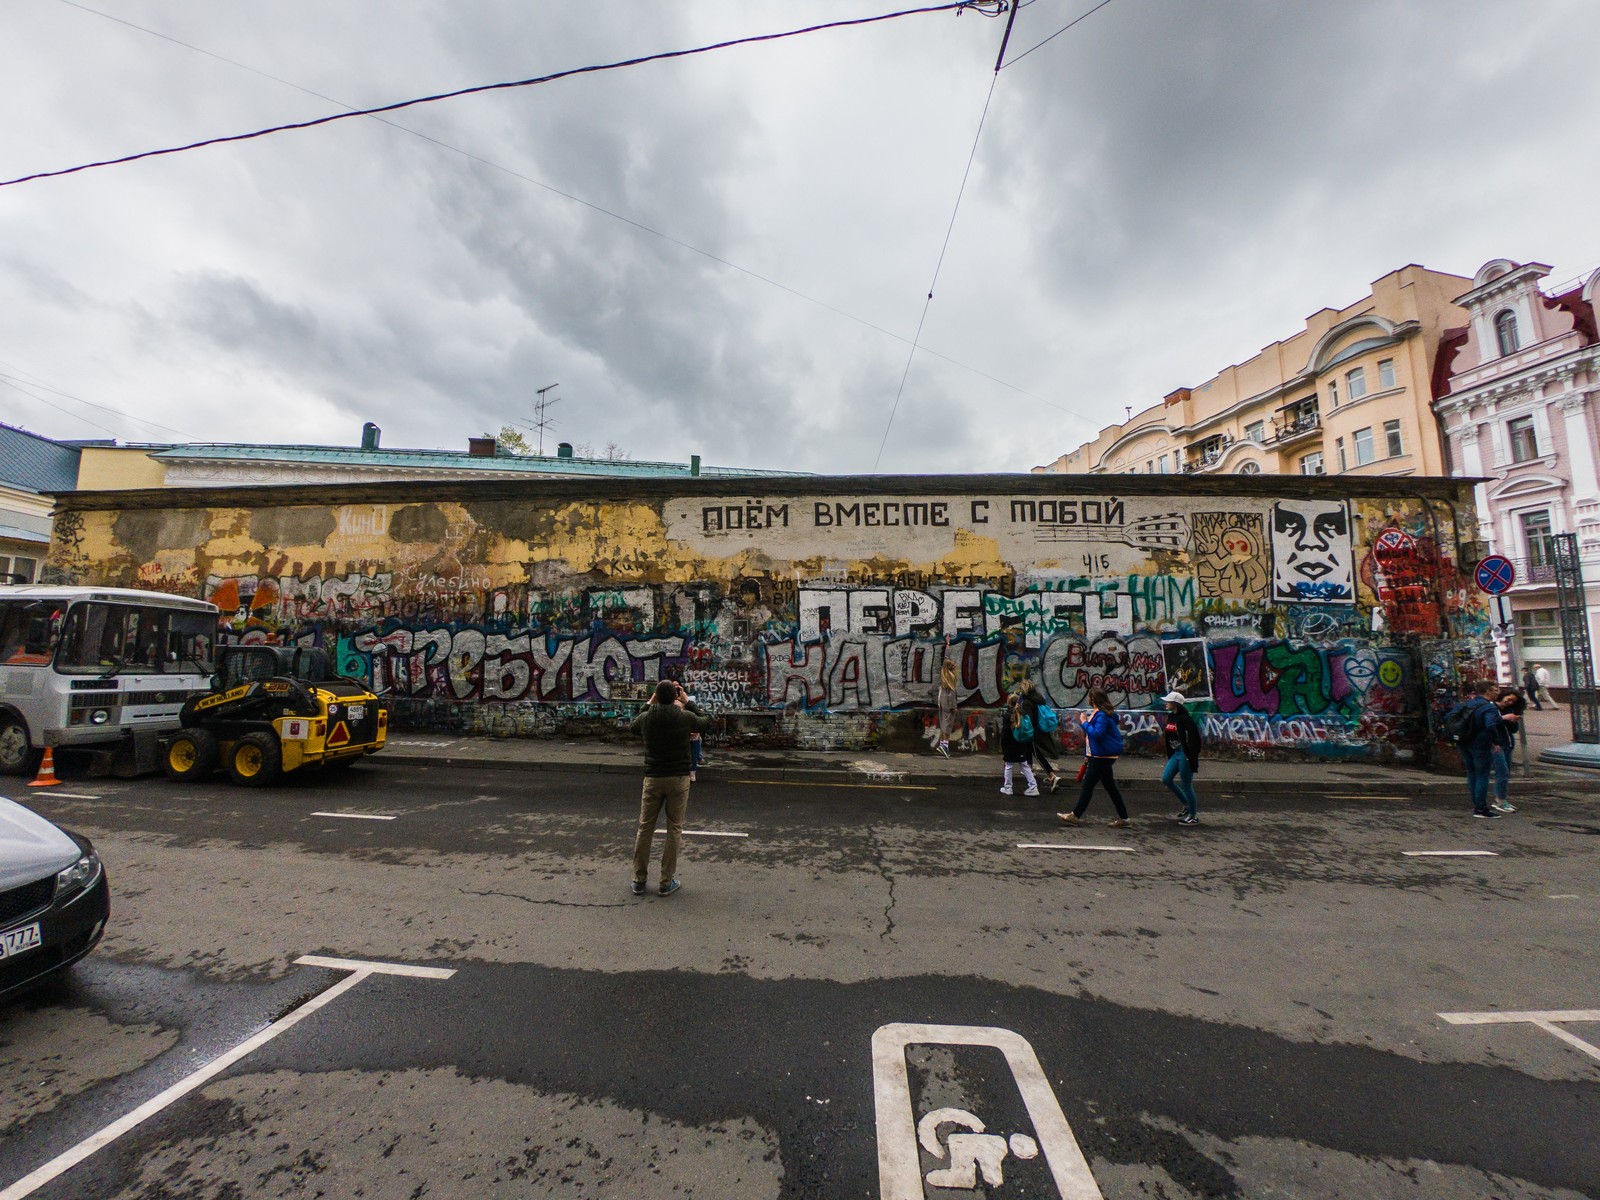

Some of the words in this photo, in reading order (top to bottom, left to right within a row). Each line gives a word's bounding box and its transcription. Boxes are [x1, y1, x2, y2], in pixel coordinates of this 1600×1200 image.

[814, 502, 949, 527] ВМЕСТЕ
[971, 500, 989, 524] С
[1010, 496, 1125, 525] ТОБОЙ
[7, 927, 34, 947] 777
